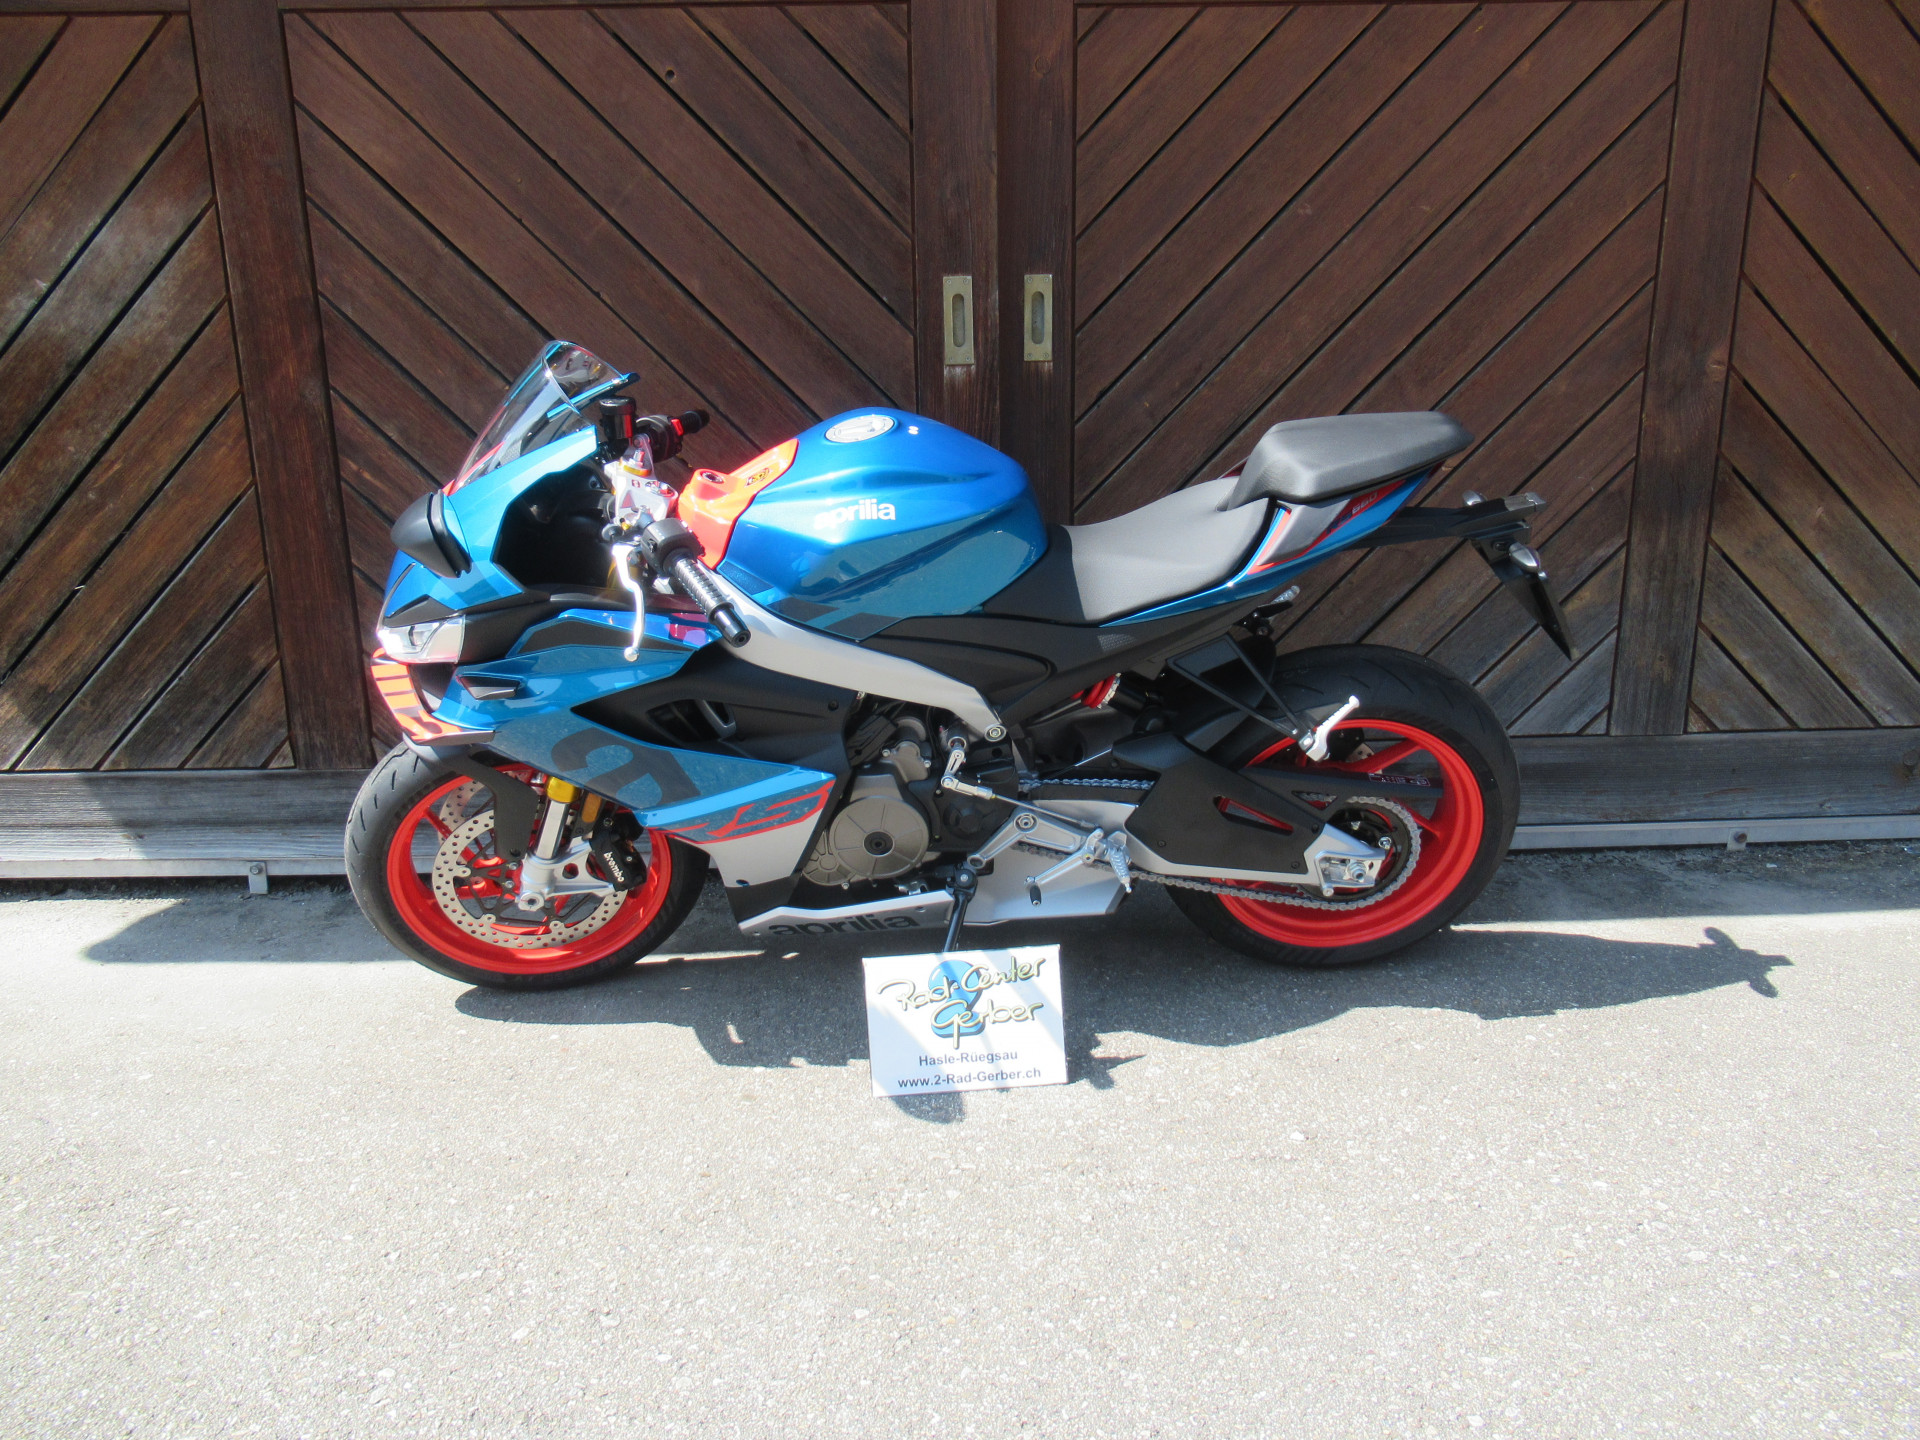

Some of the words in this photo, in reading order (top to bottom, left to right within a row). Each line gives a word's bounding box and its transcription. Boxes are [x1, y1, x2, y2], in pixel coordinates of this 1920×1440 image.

[603, 852, 625, 882] brembo
[768, 904, 920, 935] aprilia
[931, 999, 1043, 1049] Gerber
[919, 1051, 1018, 1066] Hasle-Rüegsau
[898, 1068, 1041, 1088] www.2-Rad-Gerber.ch
